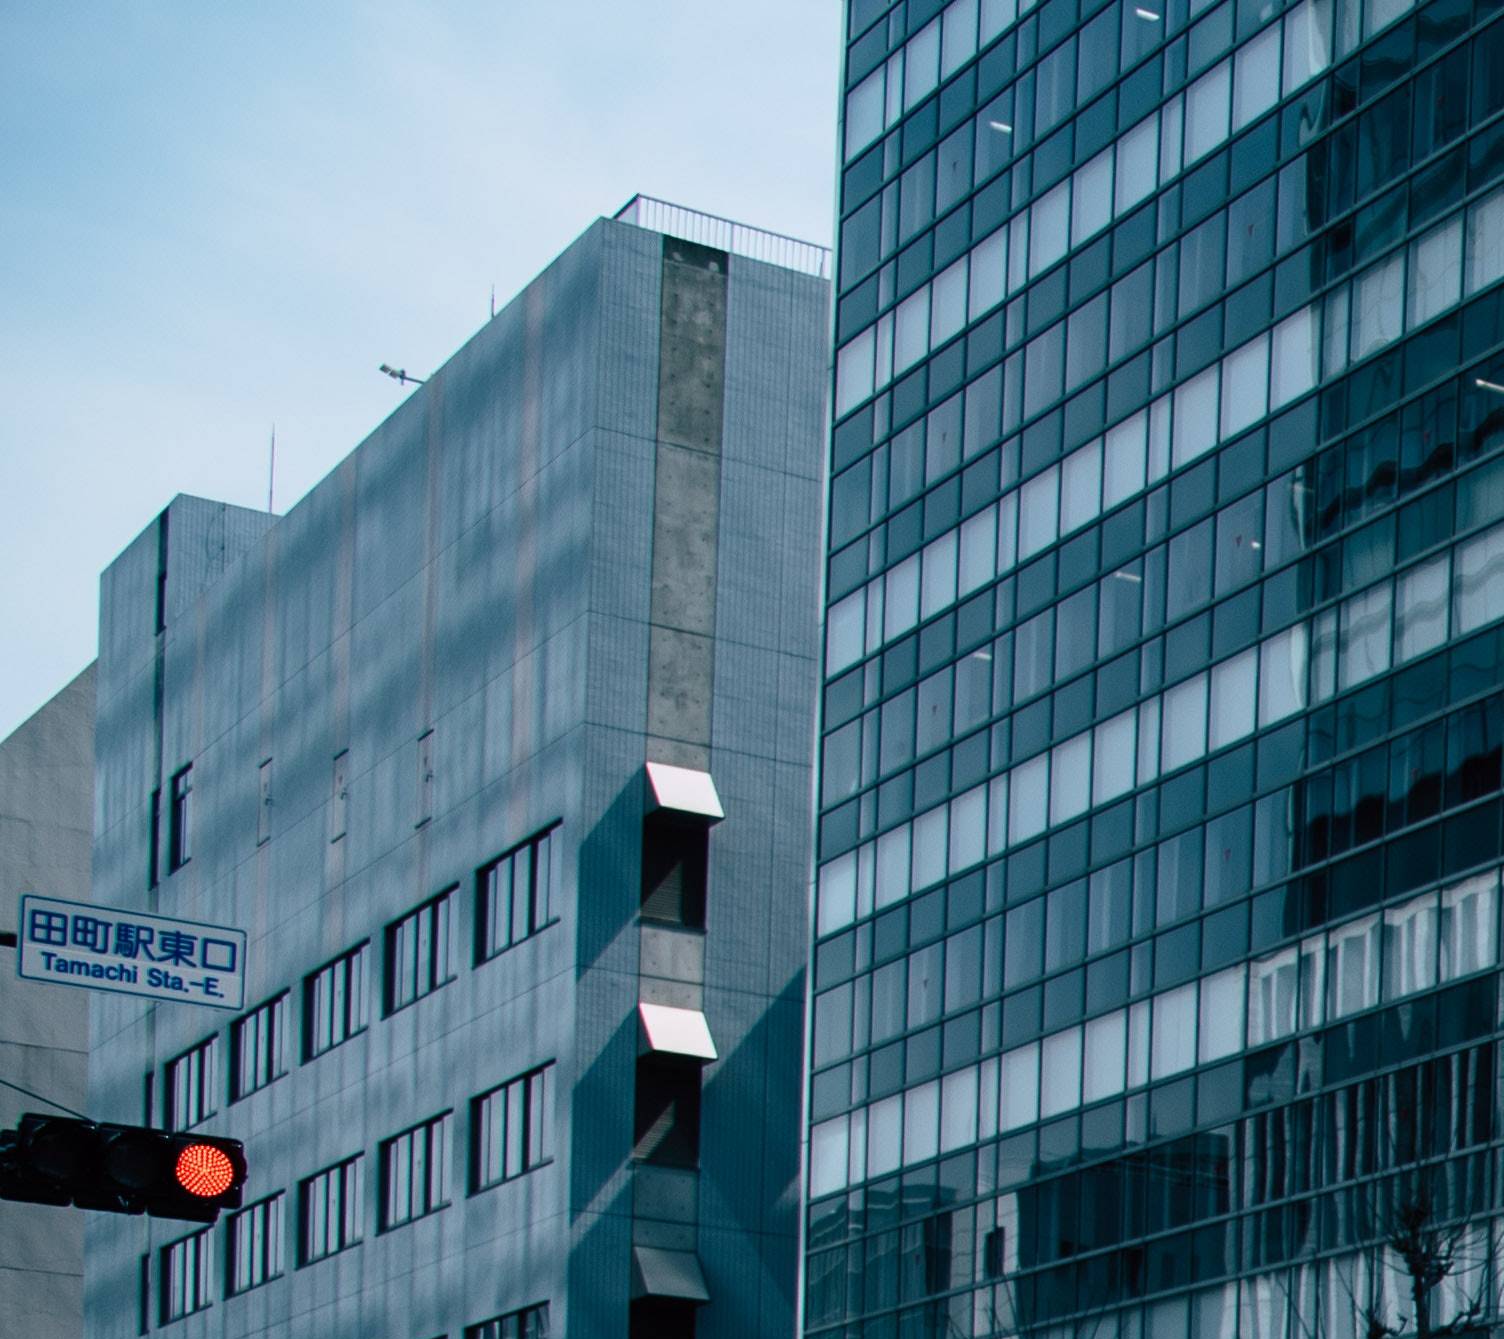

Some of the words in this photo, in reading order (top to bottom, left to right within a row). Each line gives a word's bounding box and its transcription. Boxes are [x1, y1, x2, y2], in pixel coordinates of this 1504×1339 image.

[30, 909, 236, 972] 田町駅東口
[40, 951, 138, 983] Tamachi
